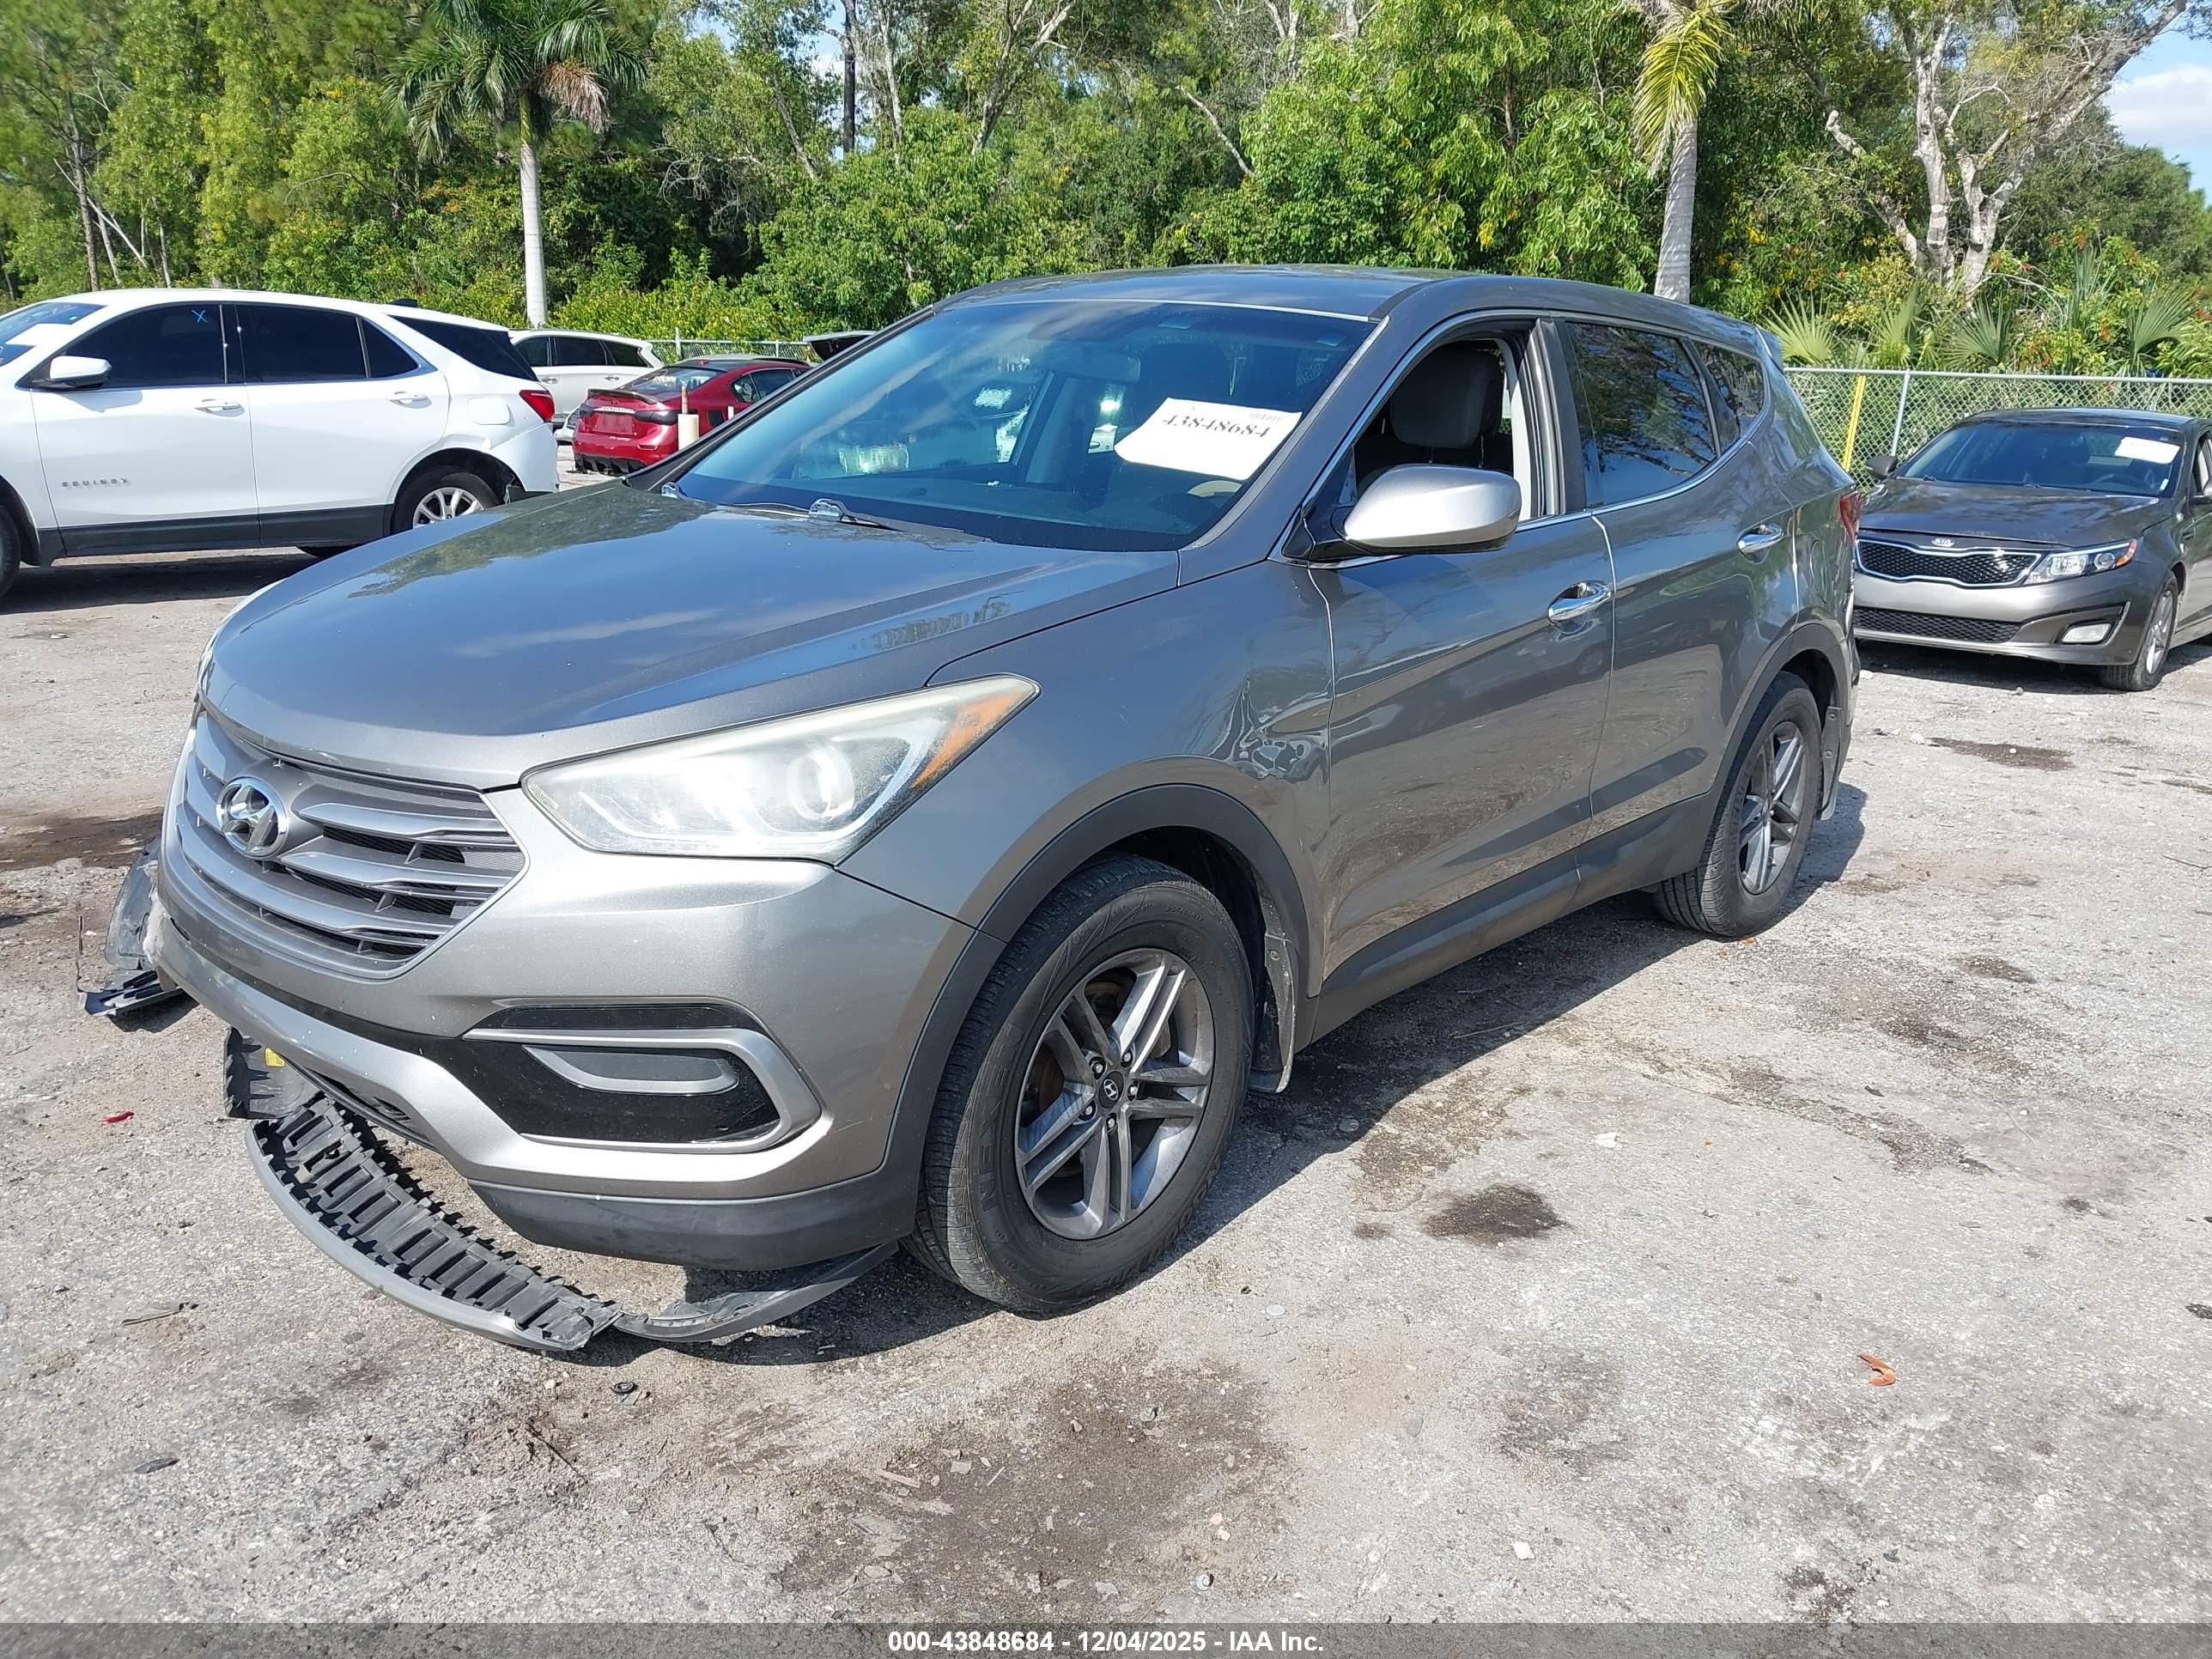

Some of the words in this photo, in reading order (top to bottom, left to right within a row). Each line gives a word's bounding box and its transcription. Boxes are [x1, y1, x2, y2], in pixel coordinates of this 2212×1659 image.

[1162, 414, 1271, 438] 43848684
[62, 477, 128, 488] EQUINOX
[978, 1023, 1024, 1212] NEXEN
